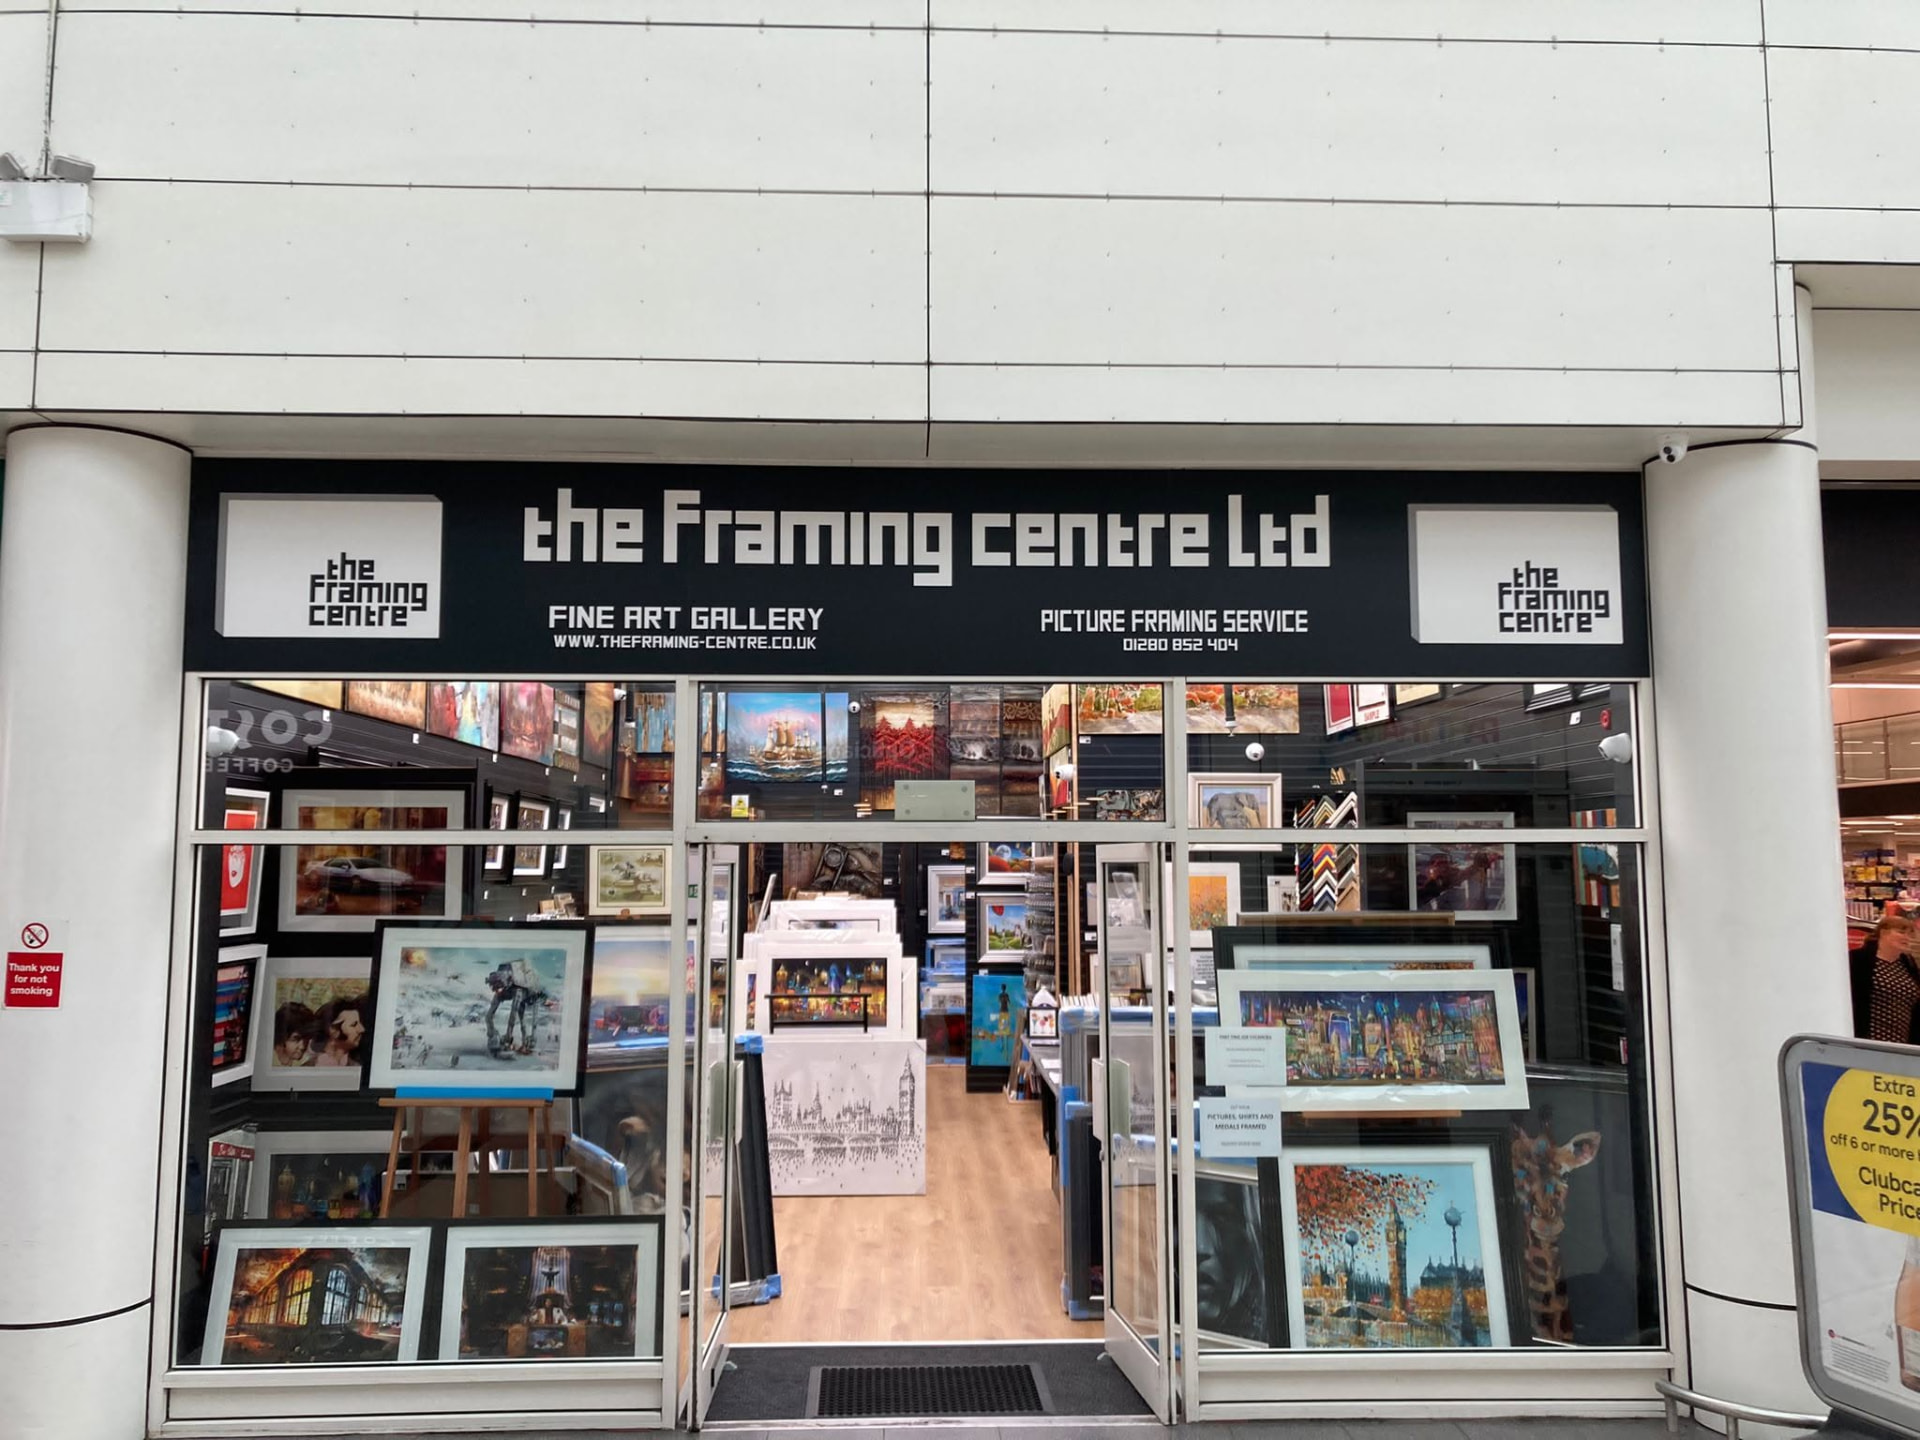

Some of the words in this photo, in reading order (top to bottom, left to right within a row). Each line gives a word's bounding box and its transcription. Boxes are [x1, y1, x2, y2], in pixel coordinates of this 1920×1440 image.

[524, 488, 644, 563] the
[971, 513, 1210, 568] centre
[327, 552, 375, 580] the
[1513, 560, 1559, 588] the
[309, 605, 408, 626] centre
[548, 605, 615, 629] FINE
[624, 606, 682, 630] ART
[691, 607, 824, 631] GALLERY
[1041, 609, 1126, 632] PICTURE
[1131, 609, 1217, 633] FRAMING
[1223, 609, 1308, 633] SERVICE
[1499, 612, 1592, 633] centre
[553, 634, 817, 650] WWW.THEFRAMING-CENTRE.CO.UK
[1123, 638, 1168, 651] 01280
[1172, 638, 1203, 651] 852
[1207, 638, 1238, 651] 404
[8, 962, 37, 972] Thank
[39, 964, 60, 974] you
[14, 974, 28, 983] for
[30, 975, 48, 984] not
[10, 985, 53, 997] smoking
[1873, 1075, 1916, 1097] Extra
[1214, 1123, 1240, 1131] MEDALS
[1240, 1123, 1267, 1131] FRAMED
[1260, 1113, 1274, 1121] AND
[1862, 1098, 1920, 1139] 25%
[1830, 1133, 1848, 1147] off
[1850, 1136, 1858, 1149] 6
[1861, 1141, 1876, 1152] or
[1878, 1144, 1915, 1161] more
